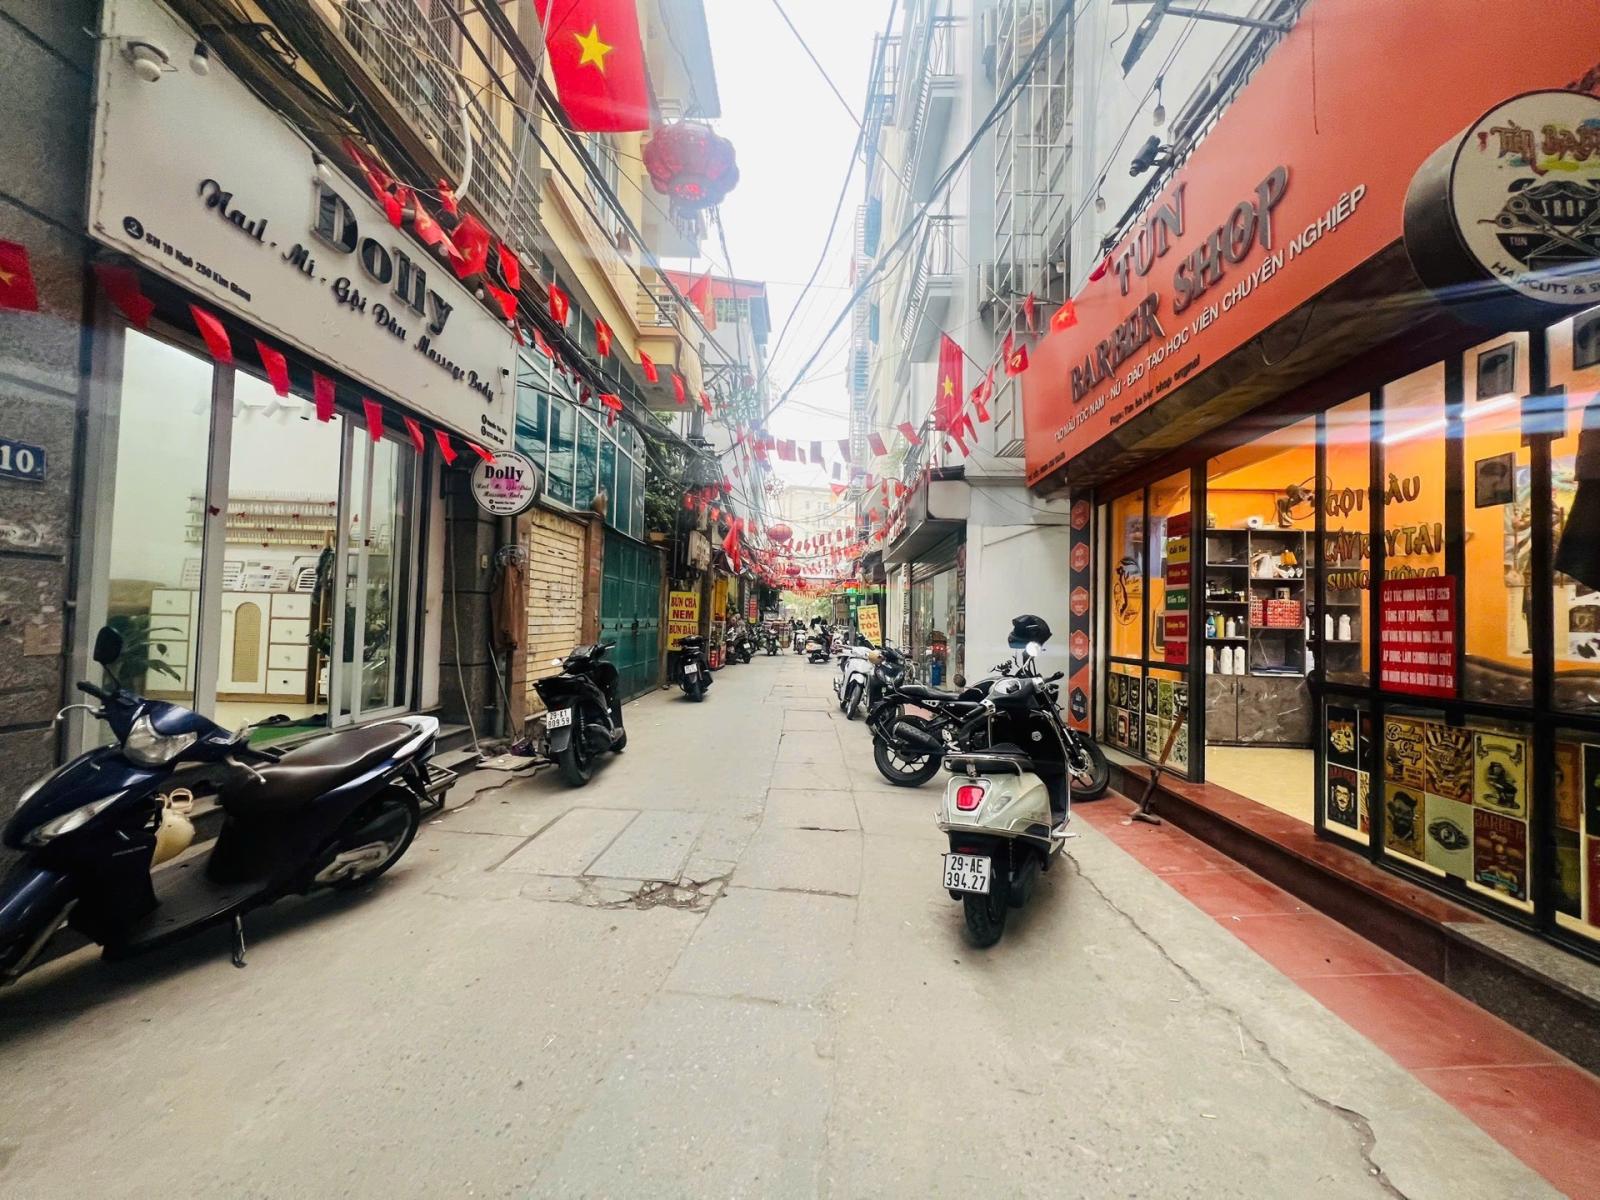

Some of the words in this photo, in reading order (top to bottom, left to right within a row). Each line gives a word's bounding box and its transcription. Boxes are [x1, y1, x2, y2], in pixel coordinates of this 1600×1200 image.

[1541, 199, 1586, 217] SHOP
[309, 176, 454, 336] Dolly
[1070, 291, 1167, 405] BARBER
[1173, 165, 1290, 316] SHOP
[1089, 395, 1106, 416] NAM
[1147, 347, 1166, 370] TẠO
[1166, 326, 1190, 352] HỌC
[1191, 304, 1220, 335] VIÊN
[1222, 249, 1285, 312] CHUYÊN
[1288, 183, 1367, 261] NGHIỆP
[414, 335, 465, 380] Massage
[467, 370, 494, 404] Body
[485, 465, 525, 482] Dolly
[1383, 472, 1421, 506] ẦU
[672, 609, 694, 619] NEM
[950, 856, 984, 874] 29-AE
[946, 871, 986, 891] 394.27
